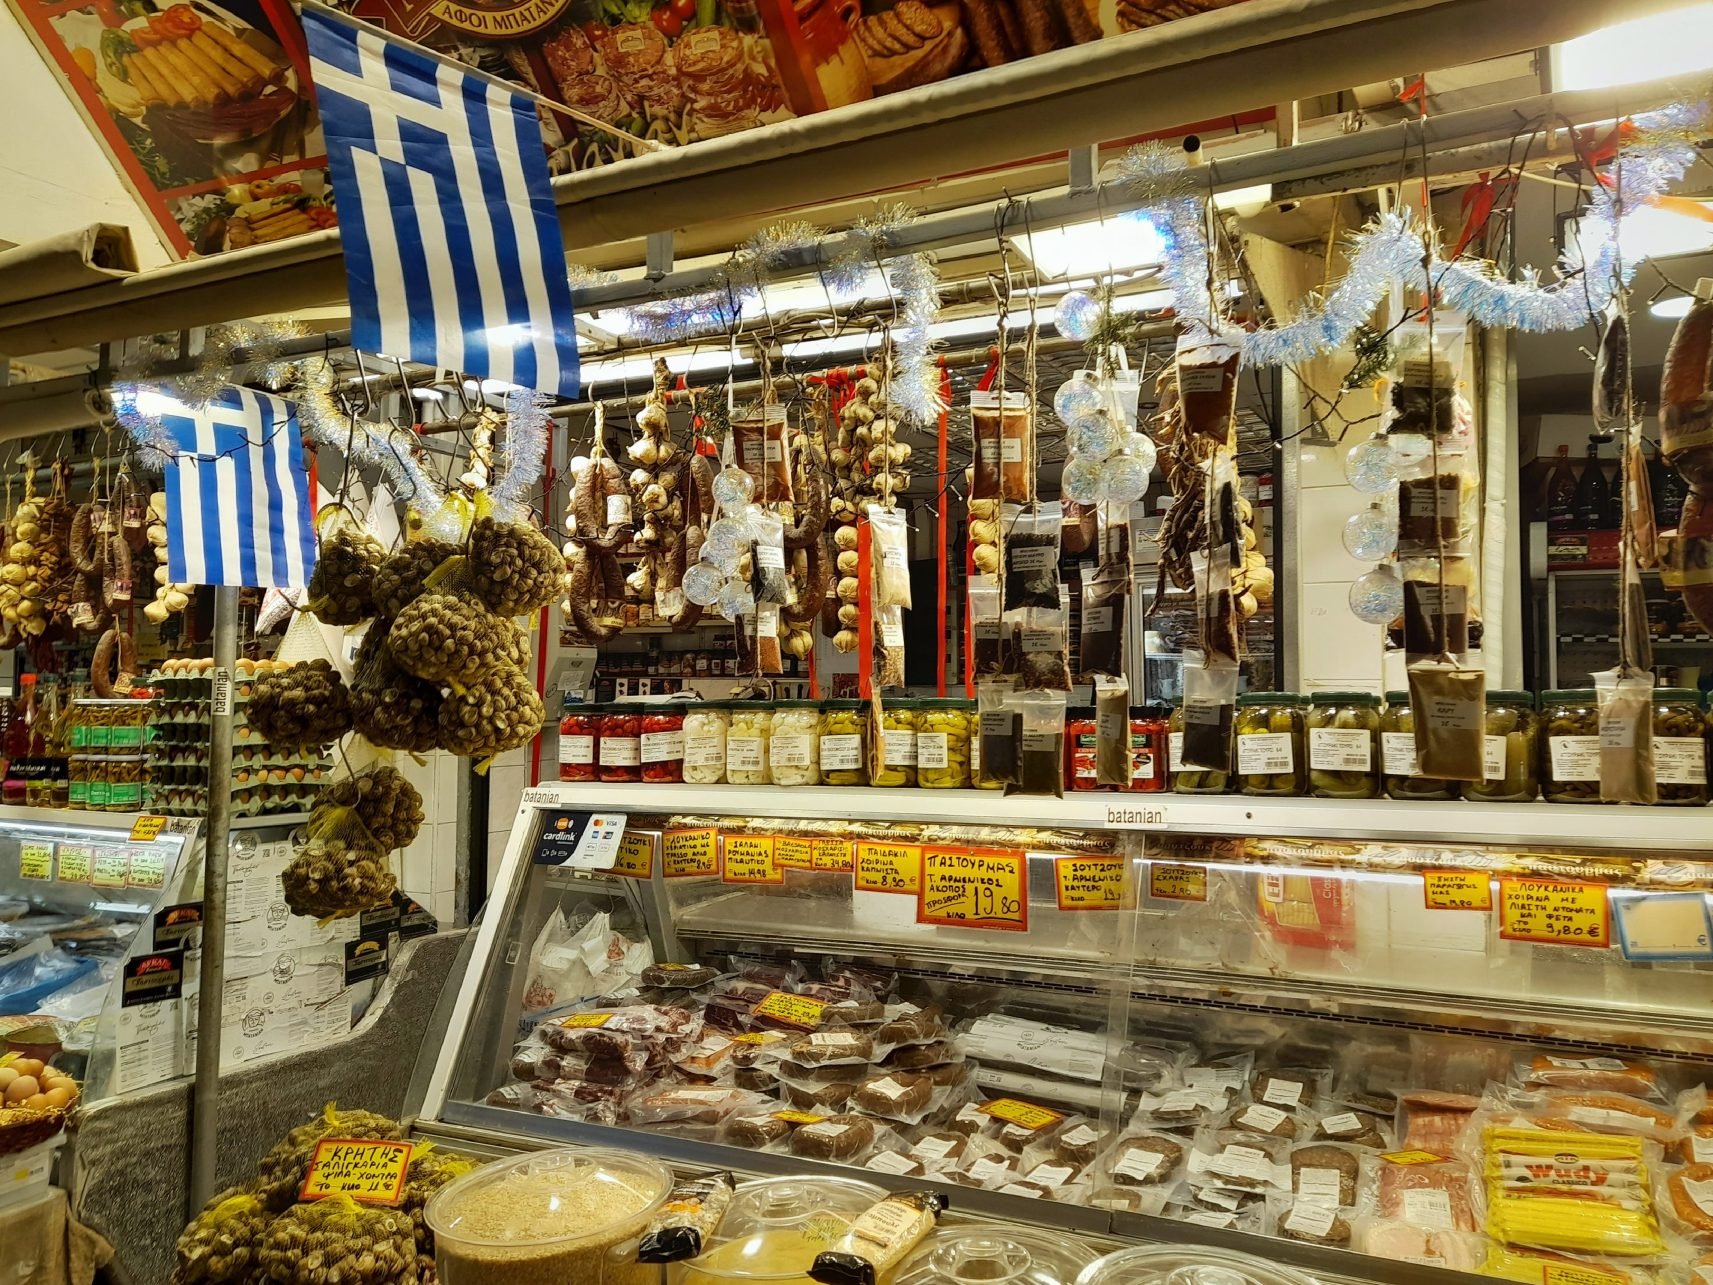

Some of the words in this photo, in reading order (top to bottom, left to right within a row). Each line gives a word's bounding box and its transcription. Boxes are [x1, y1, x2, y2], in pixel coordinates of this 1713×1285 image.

[442, 5, 488, 30] ΑΦΟΙ
[214, 671, 228, 713] batanian
[524, 790, 559, 804] batanian
[1108, 806, 1162, 825] batanian
[543, 832, 576, 841] cardlink
[927, 854, 1015, 875] ΠΑΣΤΟΥΡΜΑΣ
[929, 884, 966, 894] ΑΚΟΠΟΣ
[1519, 883, 1584, 894] ΛΟΥΚΑΝΙΚΑ
[1507, 893, 1550, 902] ΧΟΙΡΙΝΑ
[946, 911, 966, 919] ΚΙΛΟ
[331, 1146, 404, 1163] ΚΡΗΤΗΣ
[1525, 1163, 1609, 1187] Wudy
